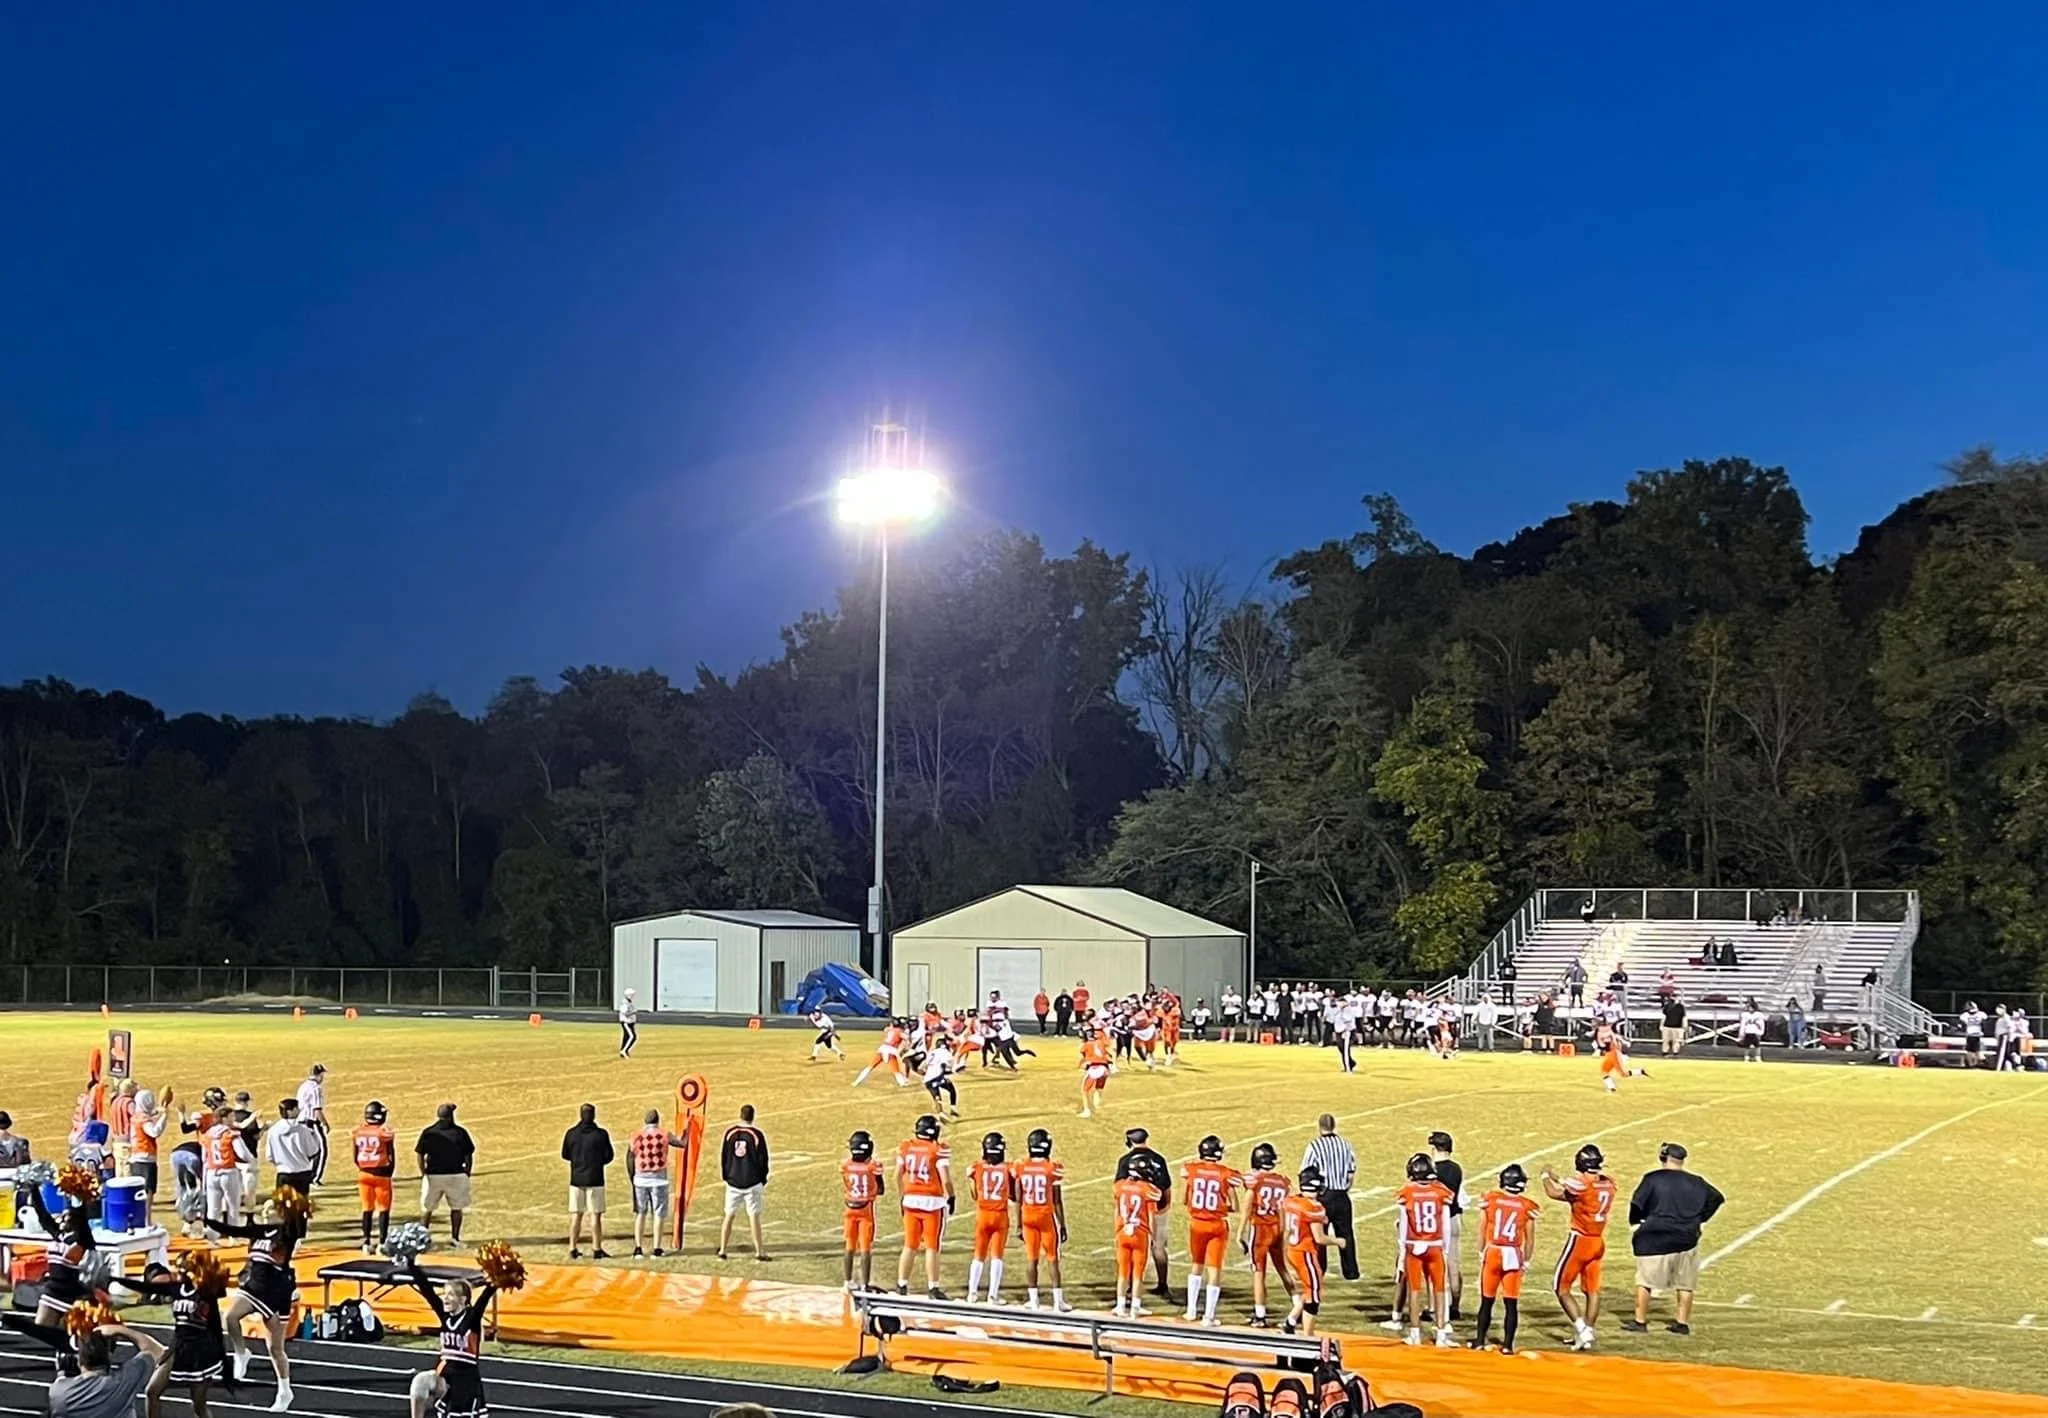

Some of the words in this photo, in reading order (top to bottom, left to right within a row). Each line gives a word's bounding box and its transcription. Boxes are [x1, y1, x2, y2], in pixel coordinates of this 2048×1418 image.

[356, 1136, 380, 1162] 22
[982, 1170, 1004, 1201] 12
[1021, 1174, 1047, 1205] 26
[1192, 1178, 1221, 1211] 66
[1413, 1201, 1437, 1233] 18
[1594, 1191, 1610, 1222] 2
[1493, 1208, 1518, 1242] 14
